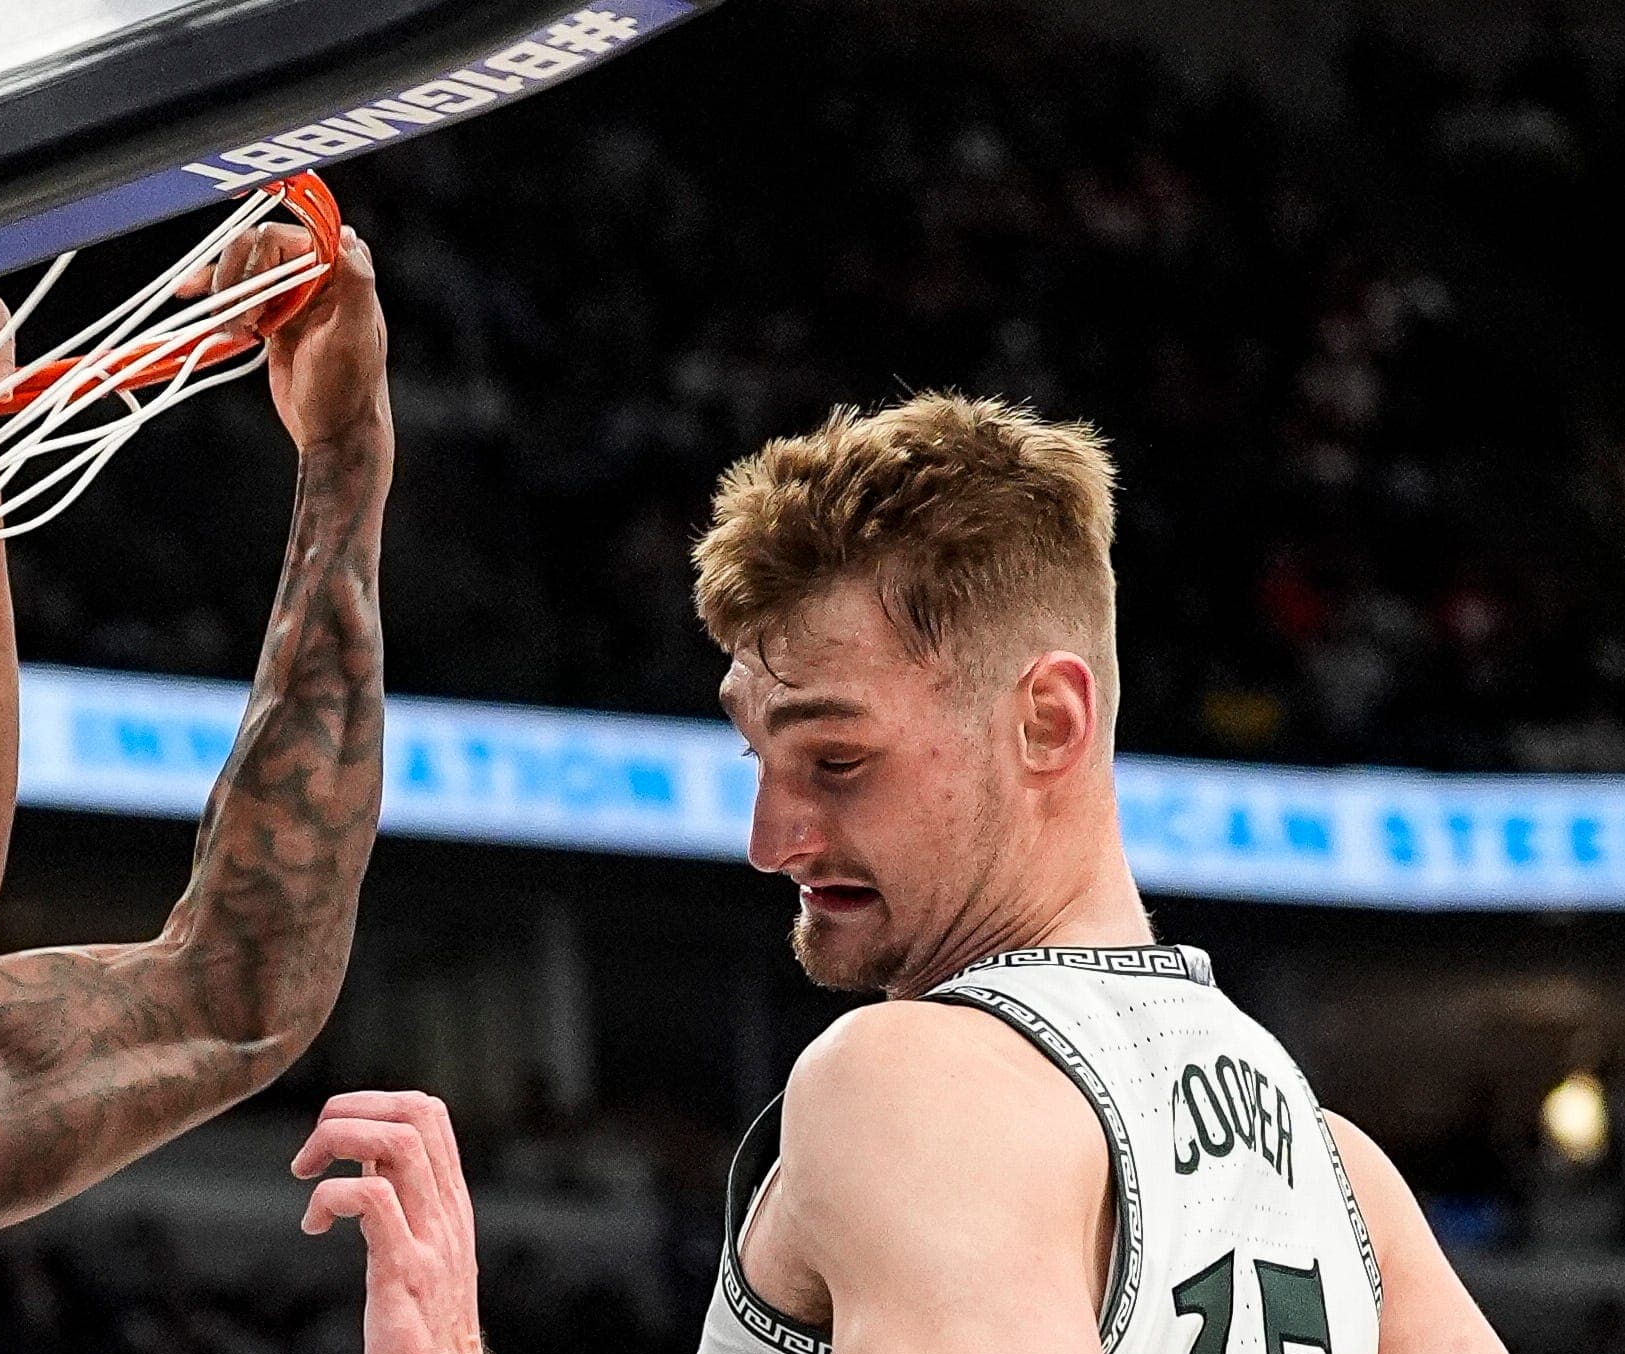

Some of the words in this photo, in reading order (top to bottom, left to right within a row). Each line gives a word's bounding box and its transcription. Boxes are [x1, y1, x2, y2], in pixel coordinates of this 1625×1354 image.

[181, 9, 639, 191] #B1GMBBT
[1381, 803, 1612, 870] STEE
[1172, 1054, 1294, 1190] COOPER
